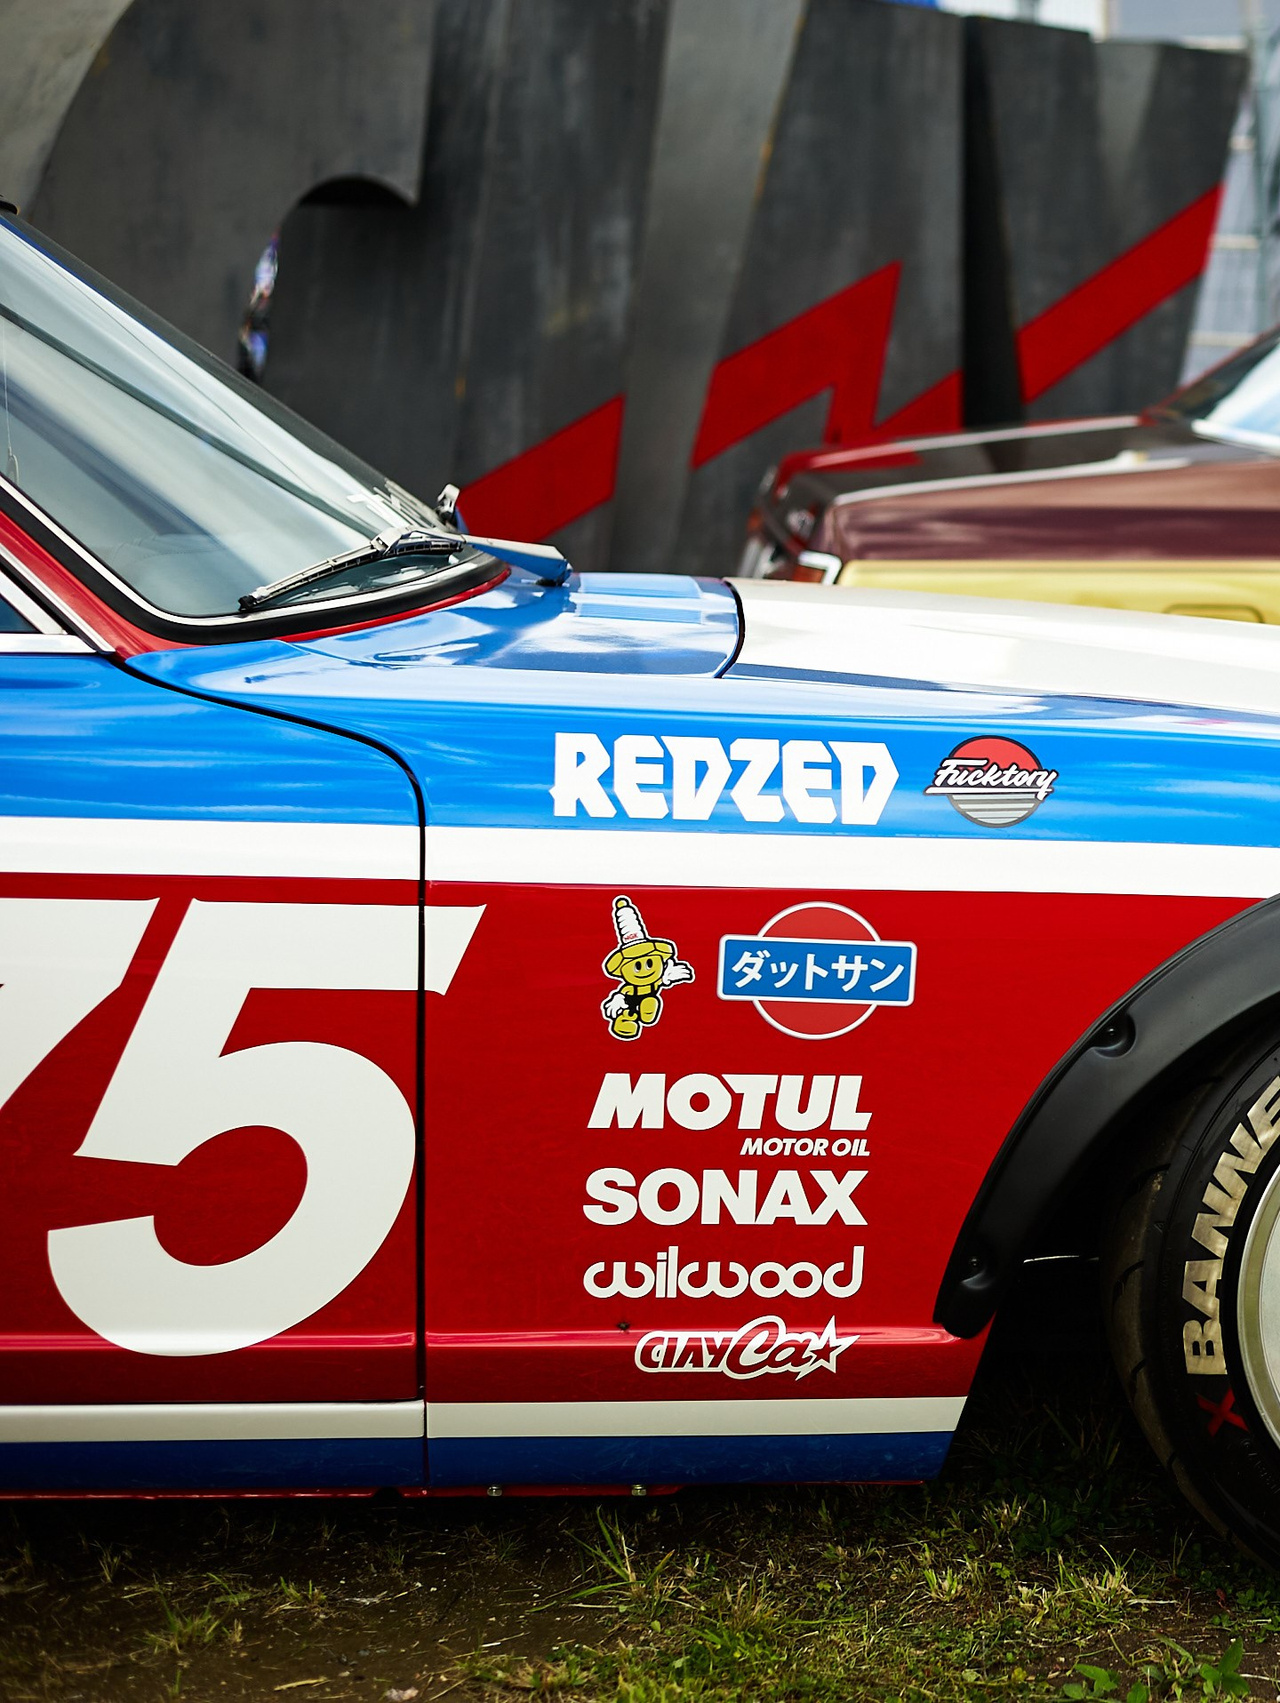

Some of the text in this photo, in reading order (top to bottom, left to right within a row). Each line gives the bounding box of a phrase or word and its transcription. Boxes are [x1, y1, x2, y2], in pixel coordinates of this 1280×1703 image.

[550, 731, 900, 826] REDZED
[926, 757, 1058, 801] Fucktory
[732, 948, 906, 994] ダットサン
[587, 1072, 873, 1131] MOTUL
[739, 1137, 871, 1157] MOTOR OIL
[583, 1167, 869, 1226] SONAX
[583, 1246, 865, 1299] wilwood
